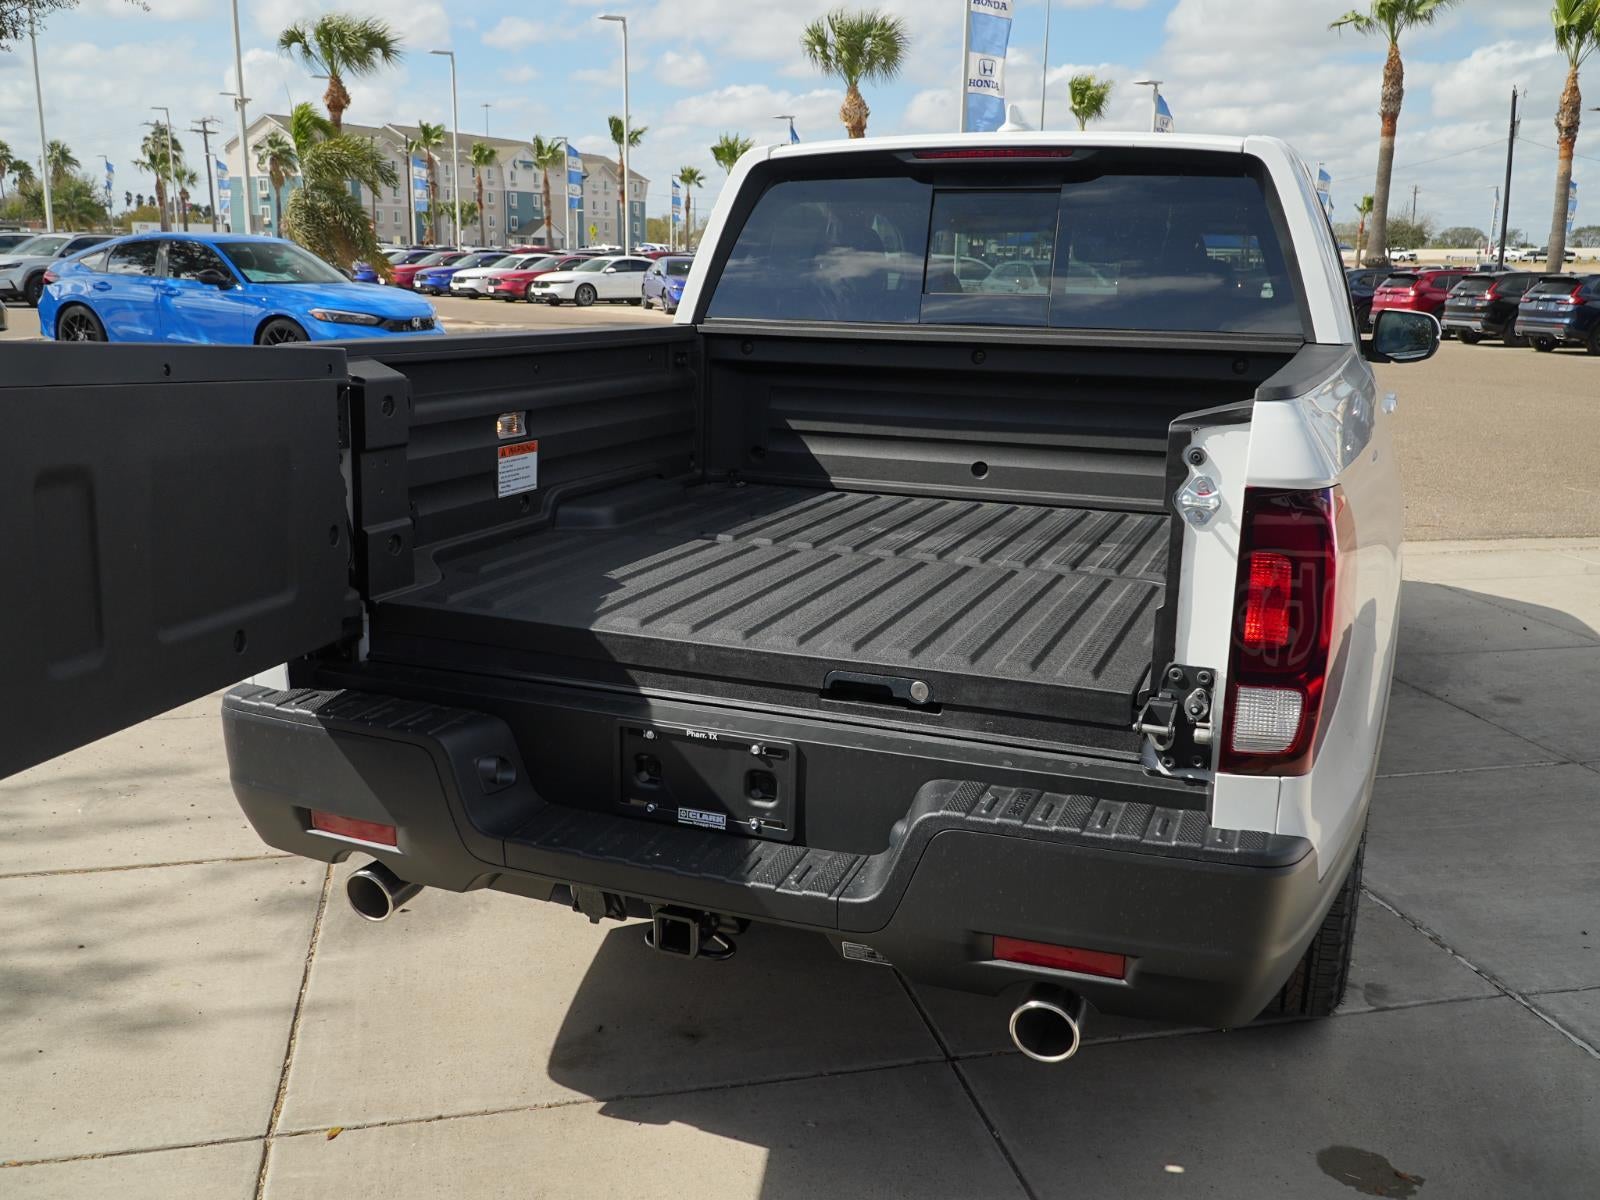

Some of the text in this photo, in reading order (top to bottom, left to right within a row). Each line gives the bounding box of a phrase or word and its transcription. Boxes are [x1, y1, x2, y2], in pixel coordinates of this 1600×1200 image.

[968, 78, 1000, 91] HONDA
[709, 732, 718, 741] TX
[689, 812, 724, 824] CLARK
